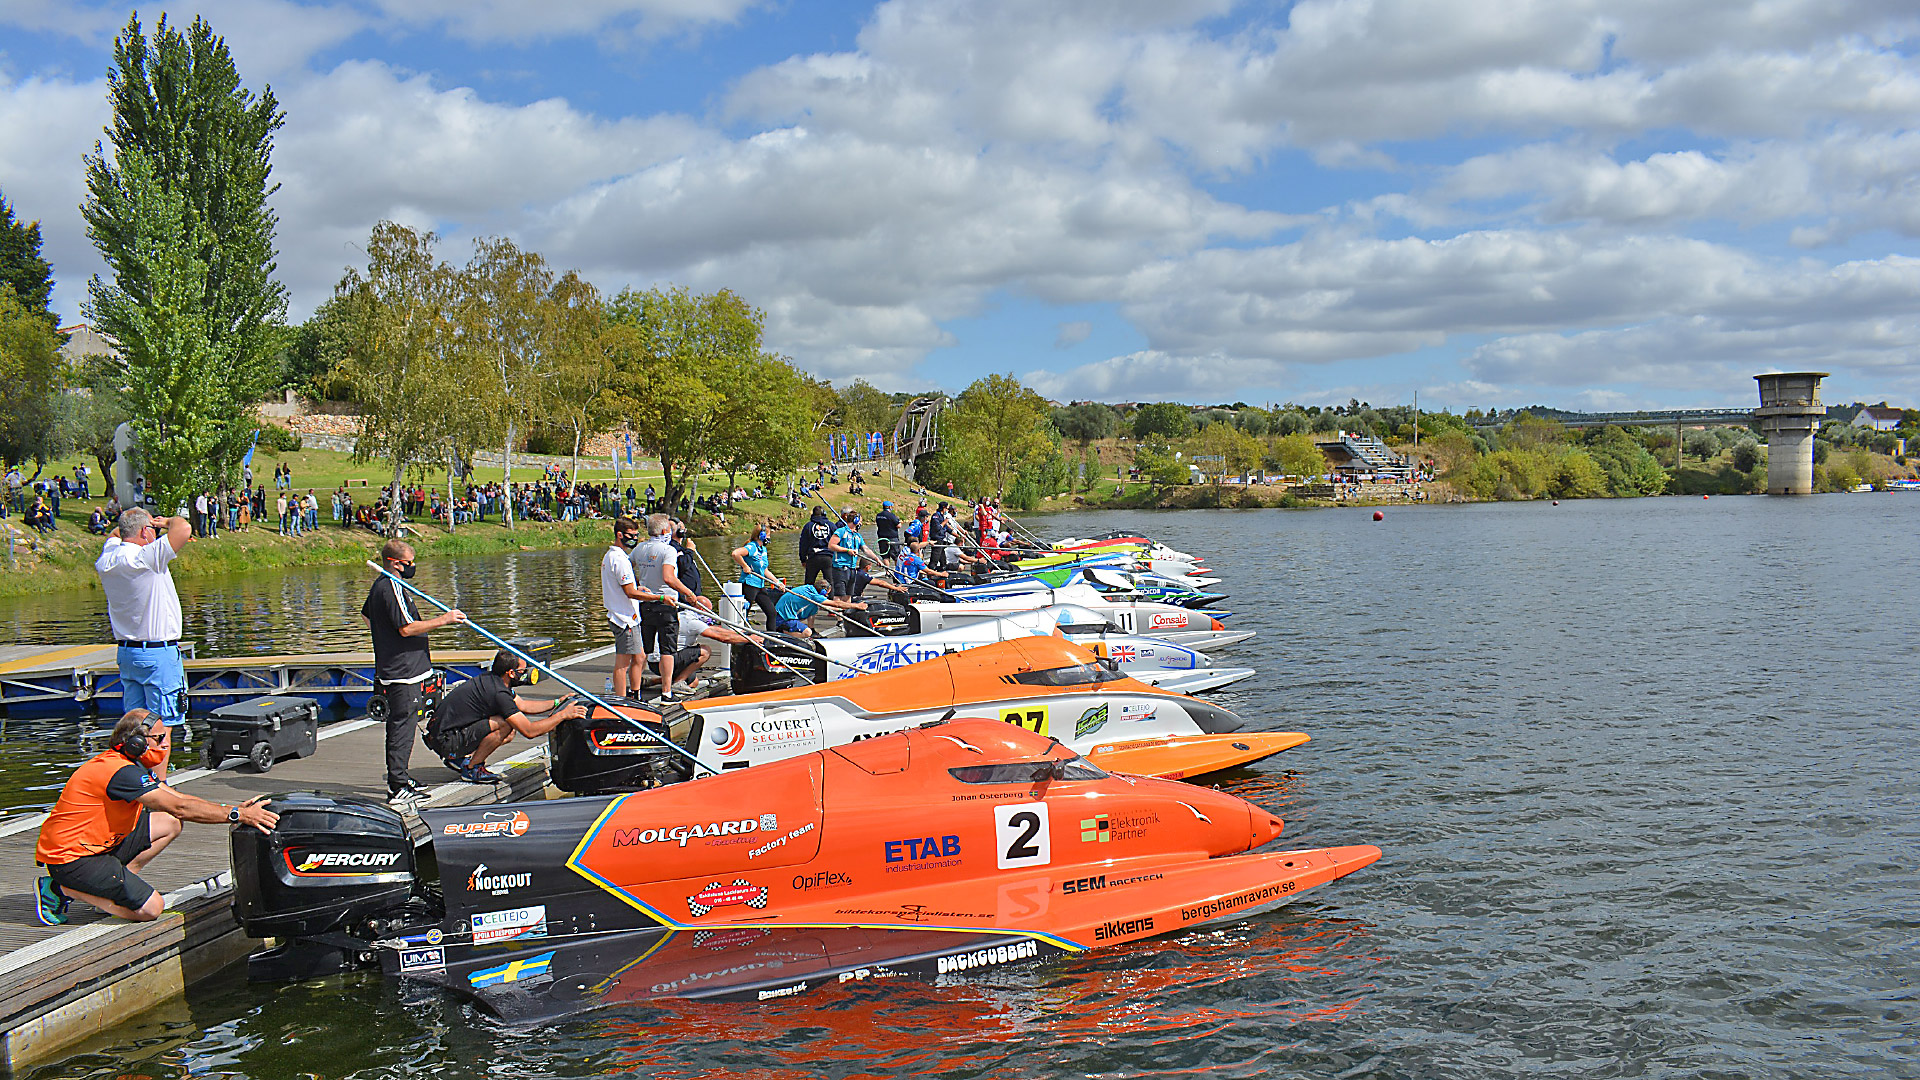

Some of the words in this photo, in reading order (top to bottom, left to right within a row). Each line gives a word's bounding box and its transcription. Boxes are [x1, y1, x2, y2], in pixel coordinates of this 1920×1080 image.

[876, 616, 906, 624] MERCURY
[1119, 612, 1133, 631] 11
[1153, 613, 1187, 626] Consale
[895, 642, 945, 664] Kin
[751, 718, 811, 734] COVERT
[752, 729, 816, 744] SECURITY
[952, 793, 977, 802] Johan
[980, 790, 1023, 801] Österberg
[444, 822, 509, 835] SUPER
[514, 820, 529, 831] B
[1110, 812, 1161, 830] Elektronik
[613, 818, 759, 848] MOLGAARD
[748, 834, 788, 860] Factory
[788, 822, 815, 840] team
[1005, 811, 1041, 860] 2
[1111, 828, 1147, 842] Partner
[884, 834, 961, 863] ETAB
[304, 852, 402, 867] MERCURY
[885, 858, 963, 874] industriautomation
[792, 871, 847, 892] OpiFlex
[1062, 874, 1106, 895] SEM
[1109, 872, 1164, 888] RACETECH
[1181, 880, 1297, 922] bergshamravarv.se
[484, 910, 528, 924] CELTEJO
[1094, 916, 1154, 941] sikkens
[403, 952, 428, 963] UIM
[937, 940, 1038, 974] DÄCKGUBBEN
